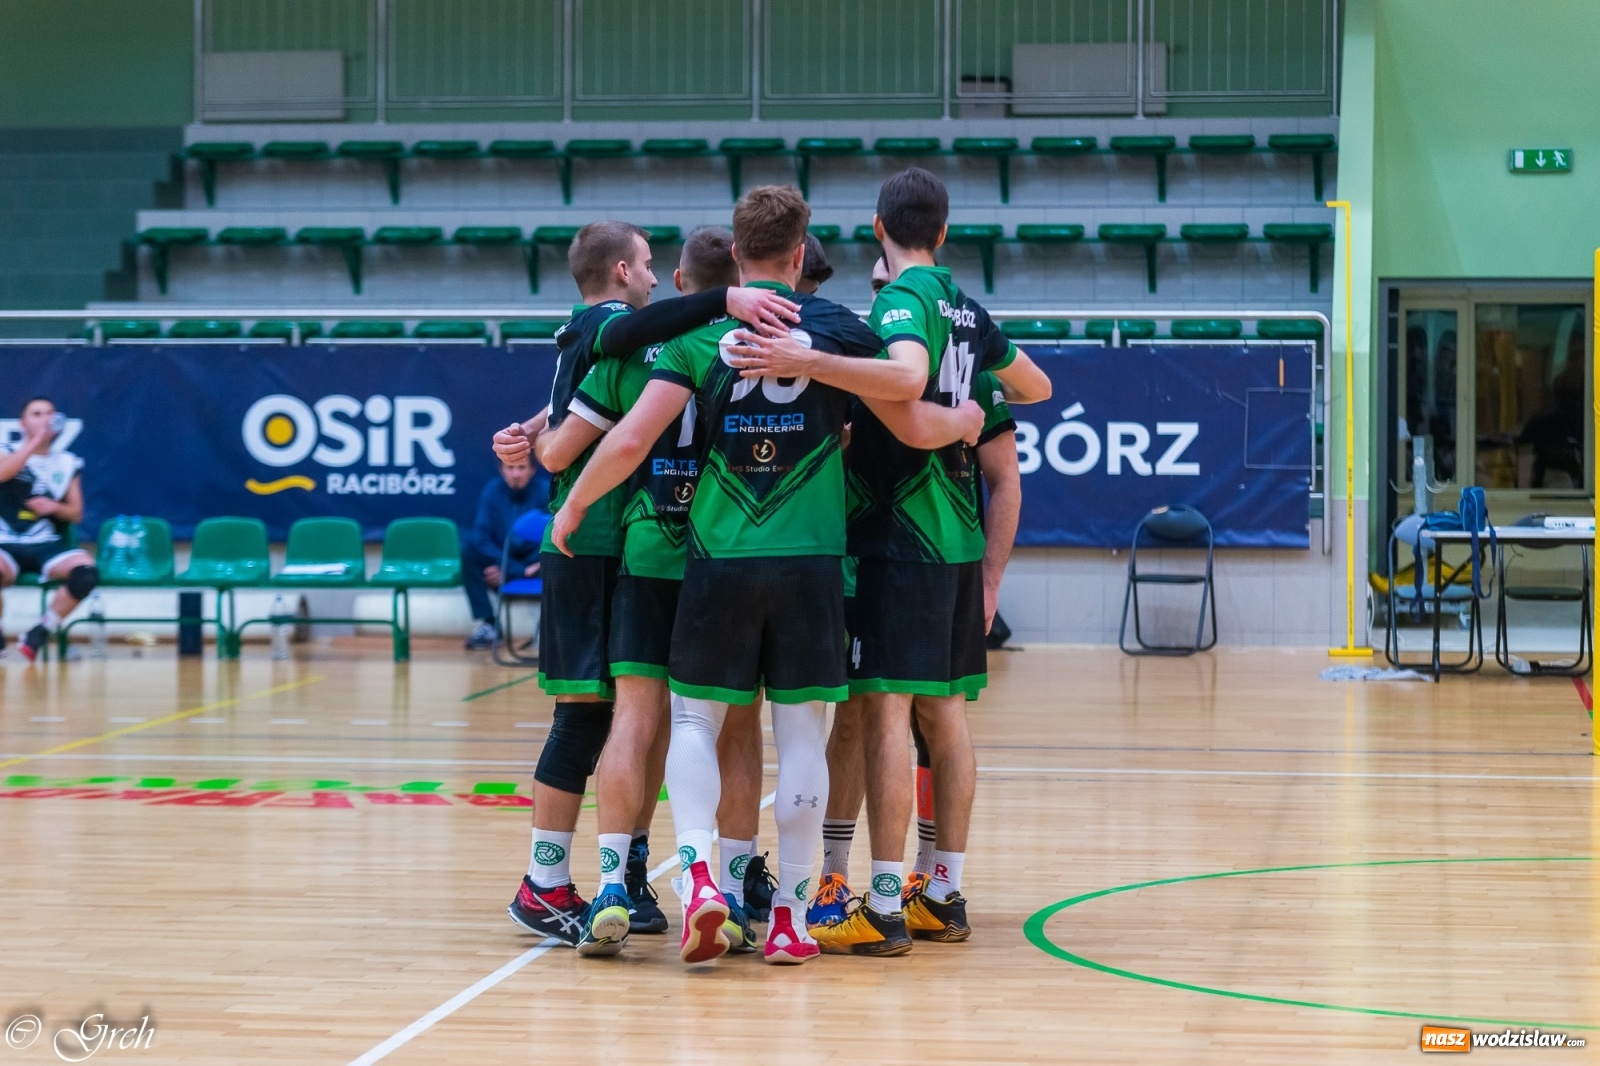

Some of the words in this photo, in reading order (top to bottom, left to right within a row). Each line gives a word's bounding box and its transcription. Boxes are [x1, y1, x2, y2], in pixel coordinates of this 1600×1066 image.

[724, 413, 804, 432] ENTECO
[745, 465, 770, 473] Studio
[326, 469, 456, 495] RACIBÓRZ
